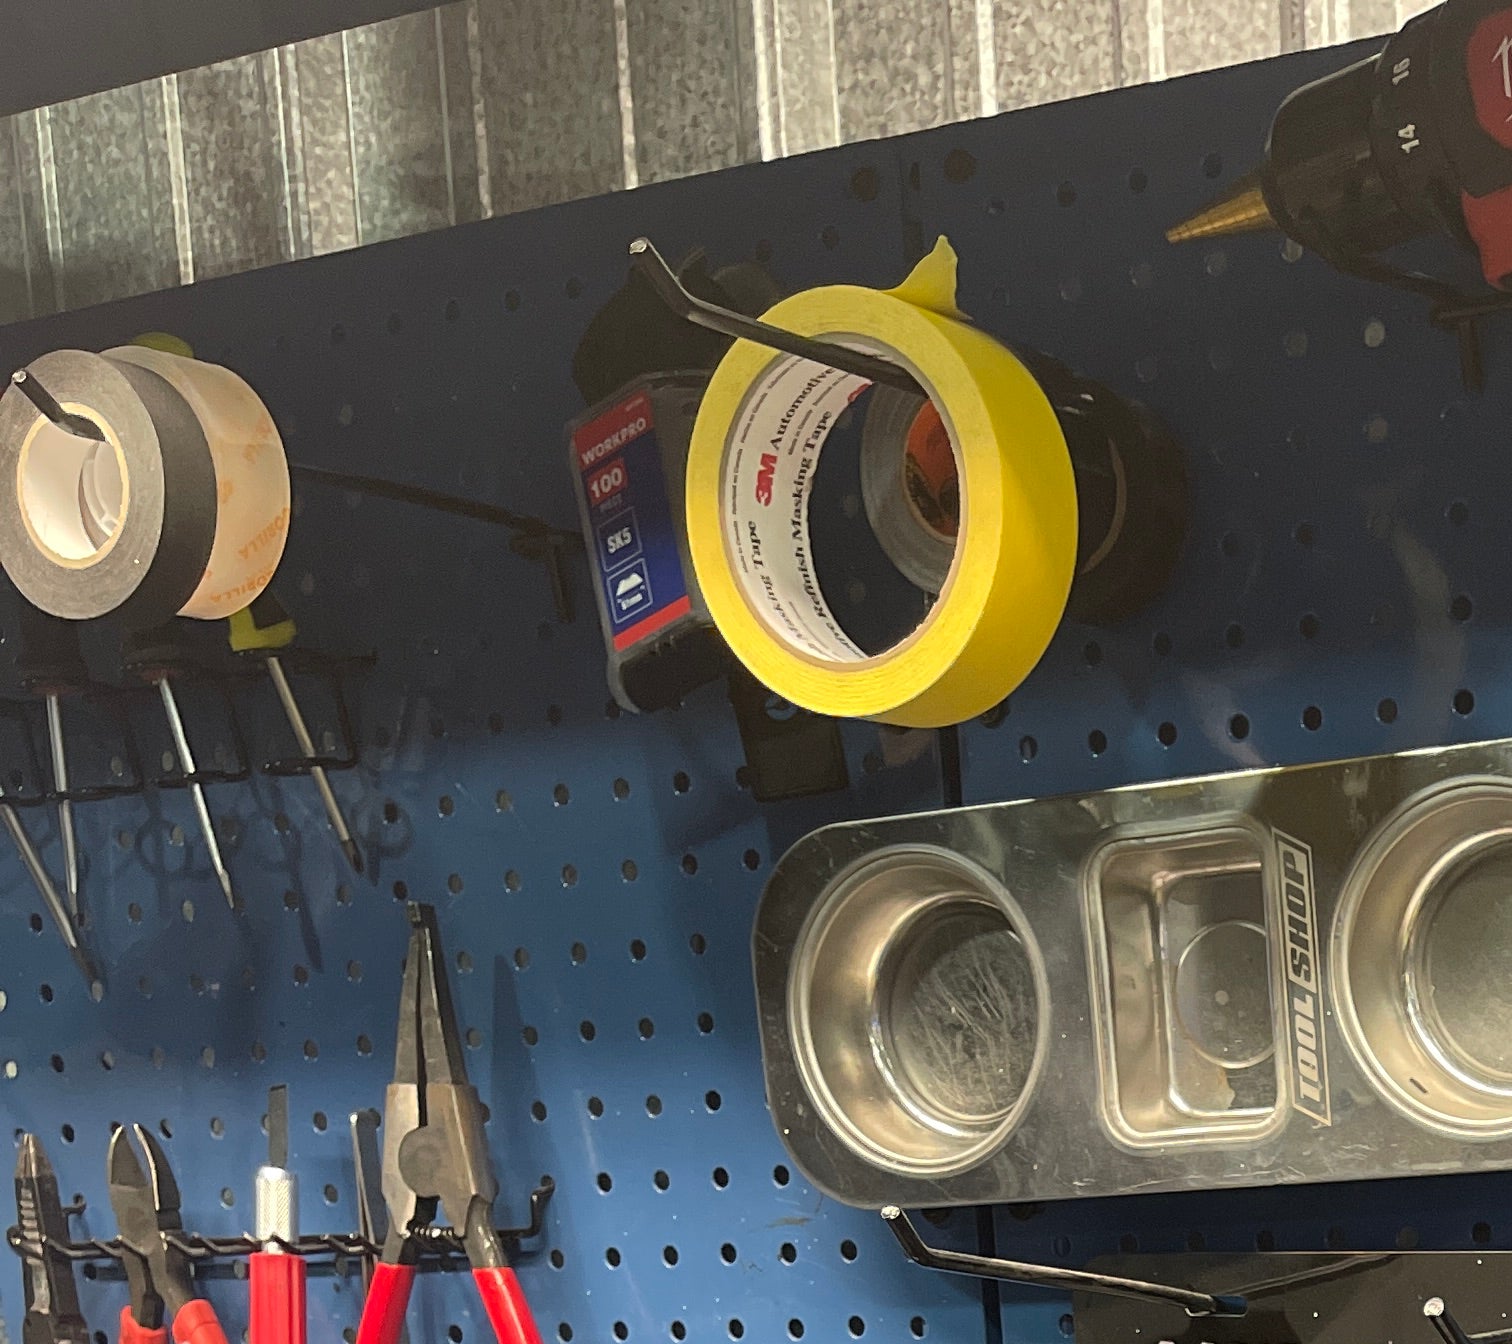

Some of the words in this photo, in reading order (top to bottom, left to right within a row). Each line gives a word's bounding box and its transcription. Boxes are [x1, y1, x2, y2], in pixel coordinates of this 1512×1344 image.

[1397, 123, 1420, 154] 14
[580, 416, 647, 465] WORKPRO
[755, 452, 779, 507] 3M
[770, 367, 836, 451] Automotive
[802, 410, 833, 454] Tape
[590, 467, 623, 499] 100
[790, 457, 814, 542] Masking
[238, 505, 290, 560] ORILLA
[747, 520, 765, 570] Tape
[209, 565, 274, 602] ORILLA
[795, 547, 828, 620] Refinish
[1281, 850, 1313, 985] SHOP
[1292, 993, 1323, 1103] TOOL
